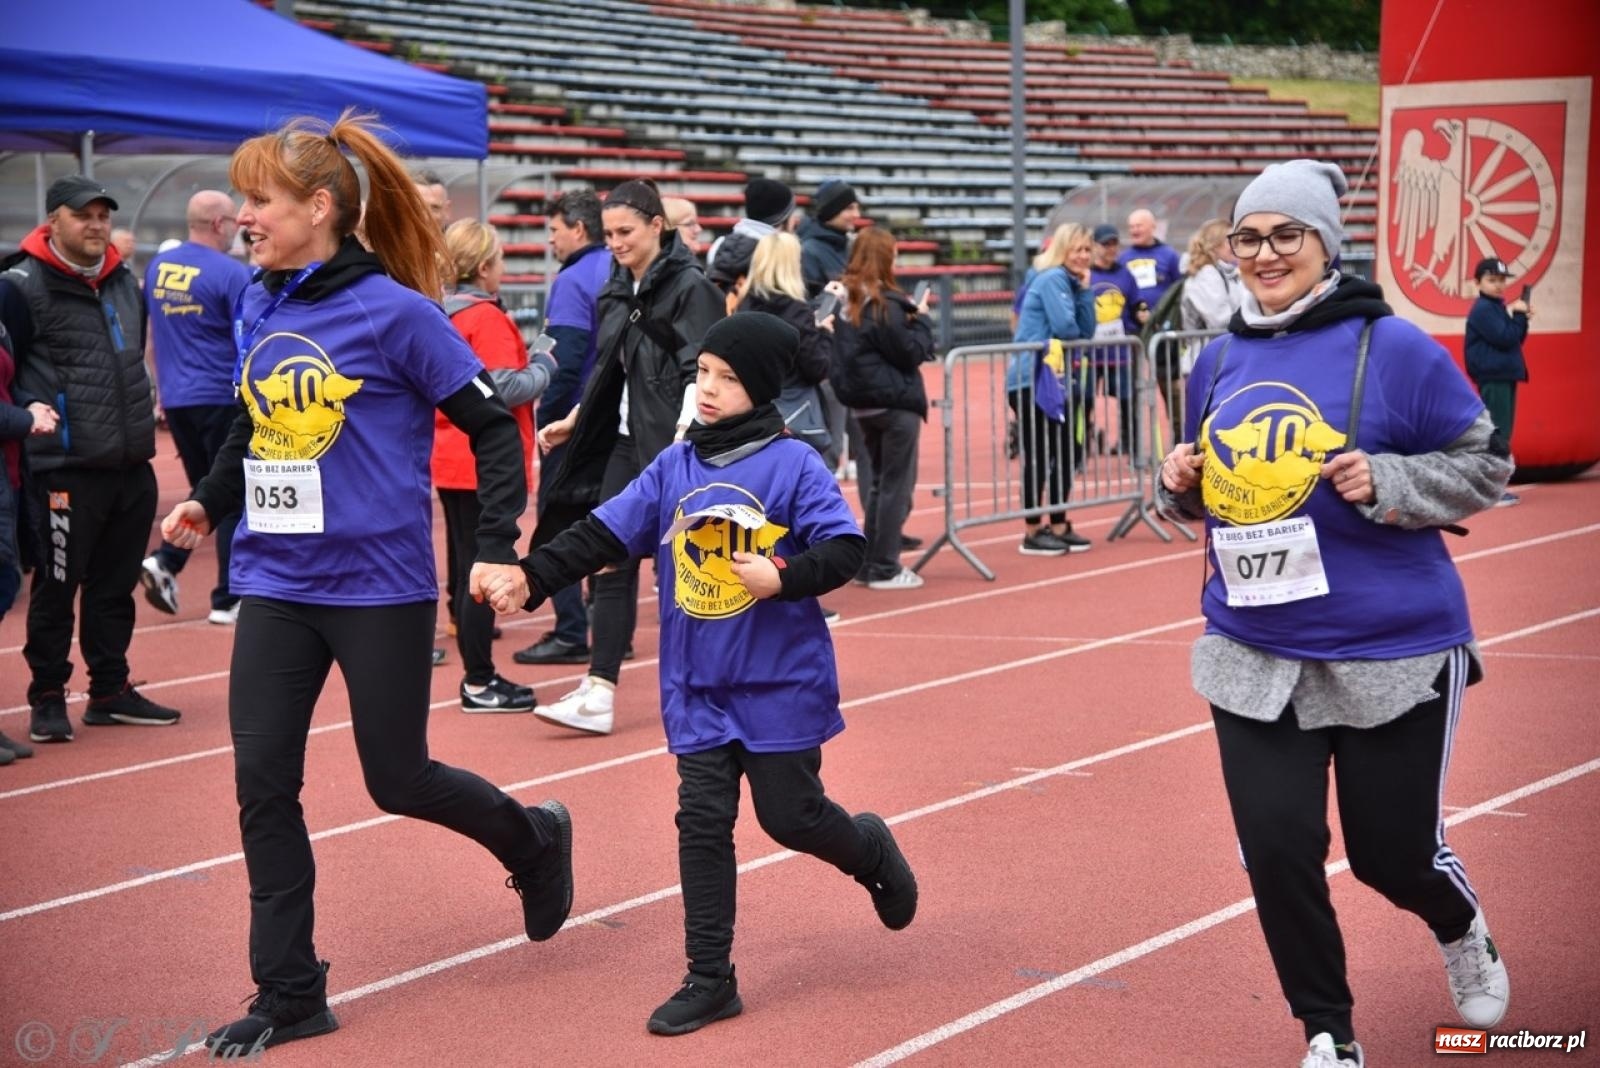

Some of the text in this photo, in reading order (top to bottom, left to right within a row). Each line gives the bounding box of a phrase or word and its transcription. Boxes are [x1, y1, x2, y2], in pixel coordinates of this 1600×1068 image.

[279, 368, 325, 412] 10
[1251, 414, 1306, 462] 10
[254, 485, 298, 509] 053
[49, 510, 70, 582] Zeus
[1245, 529, 1264, 540] BEZ
[1236, 549, 1290, 580] 077
